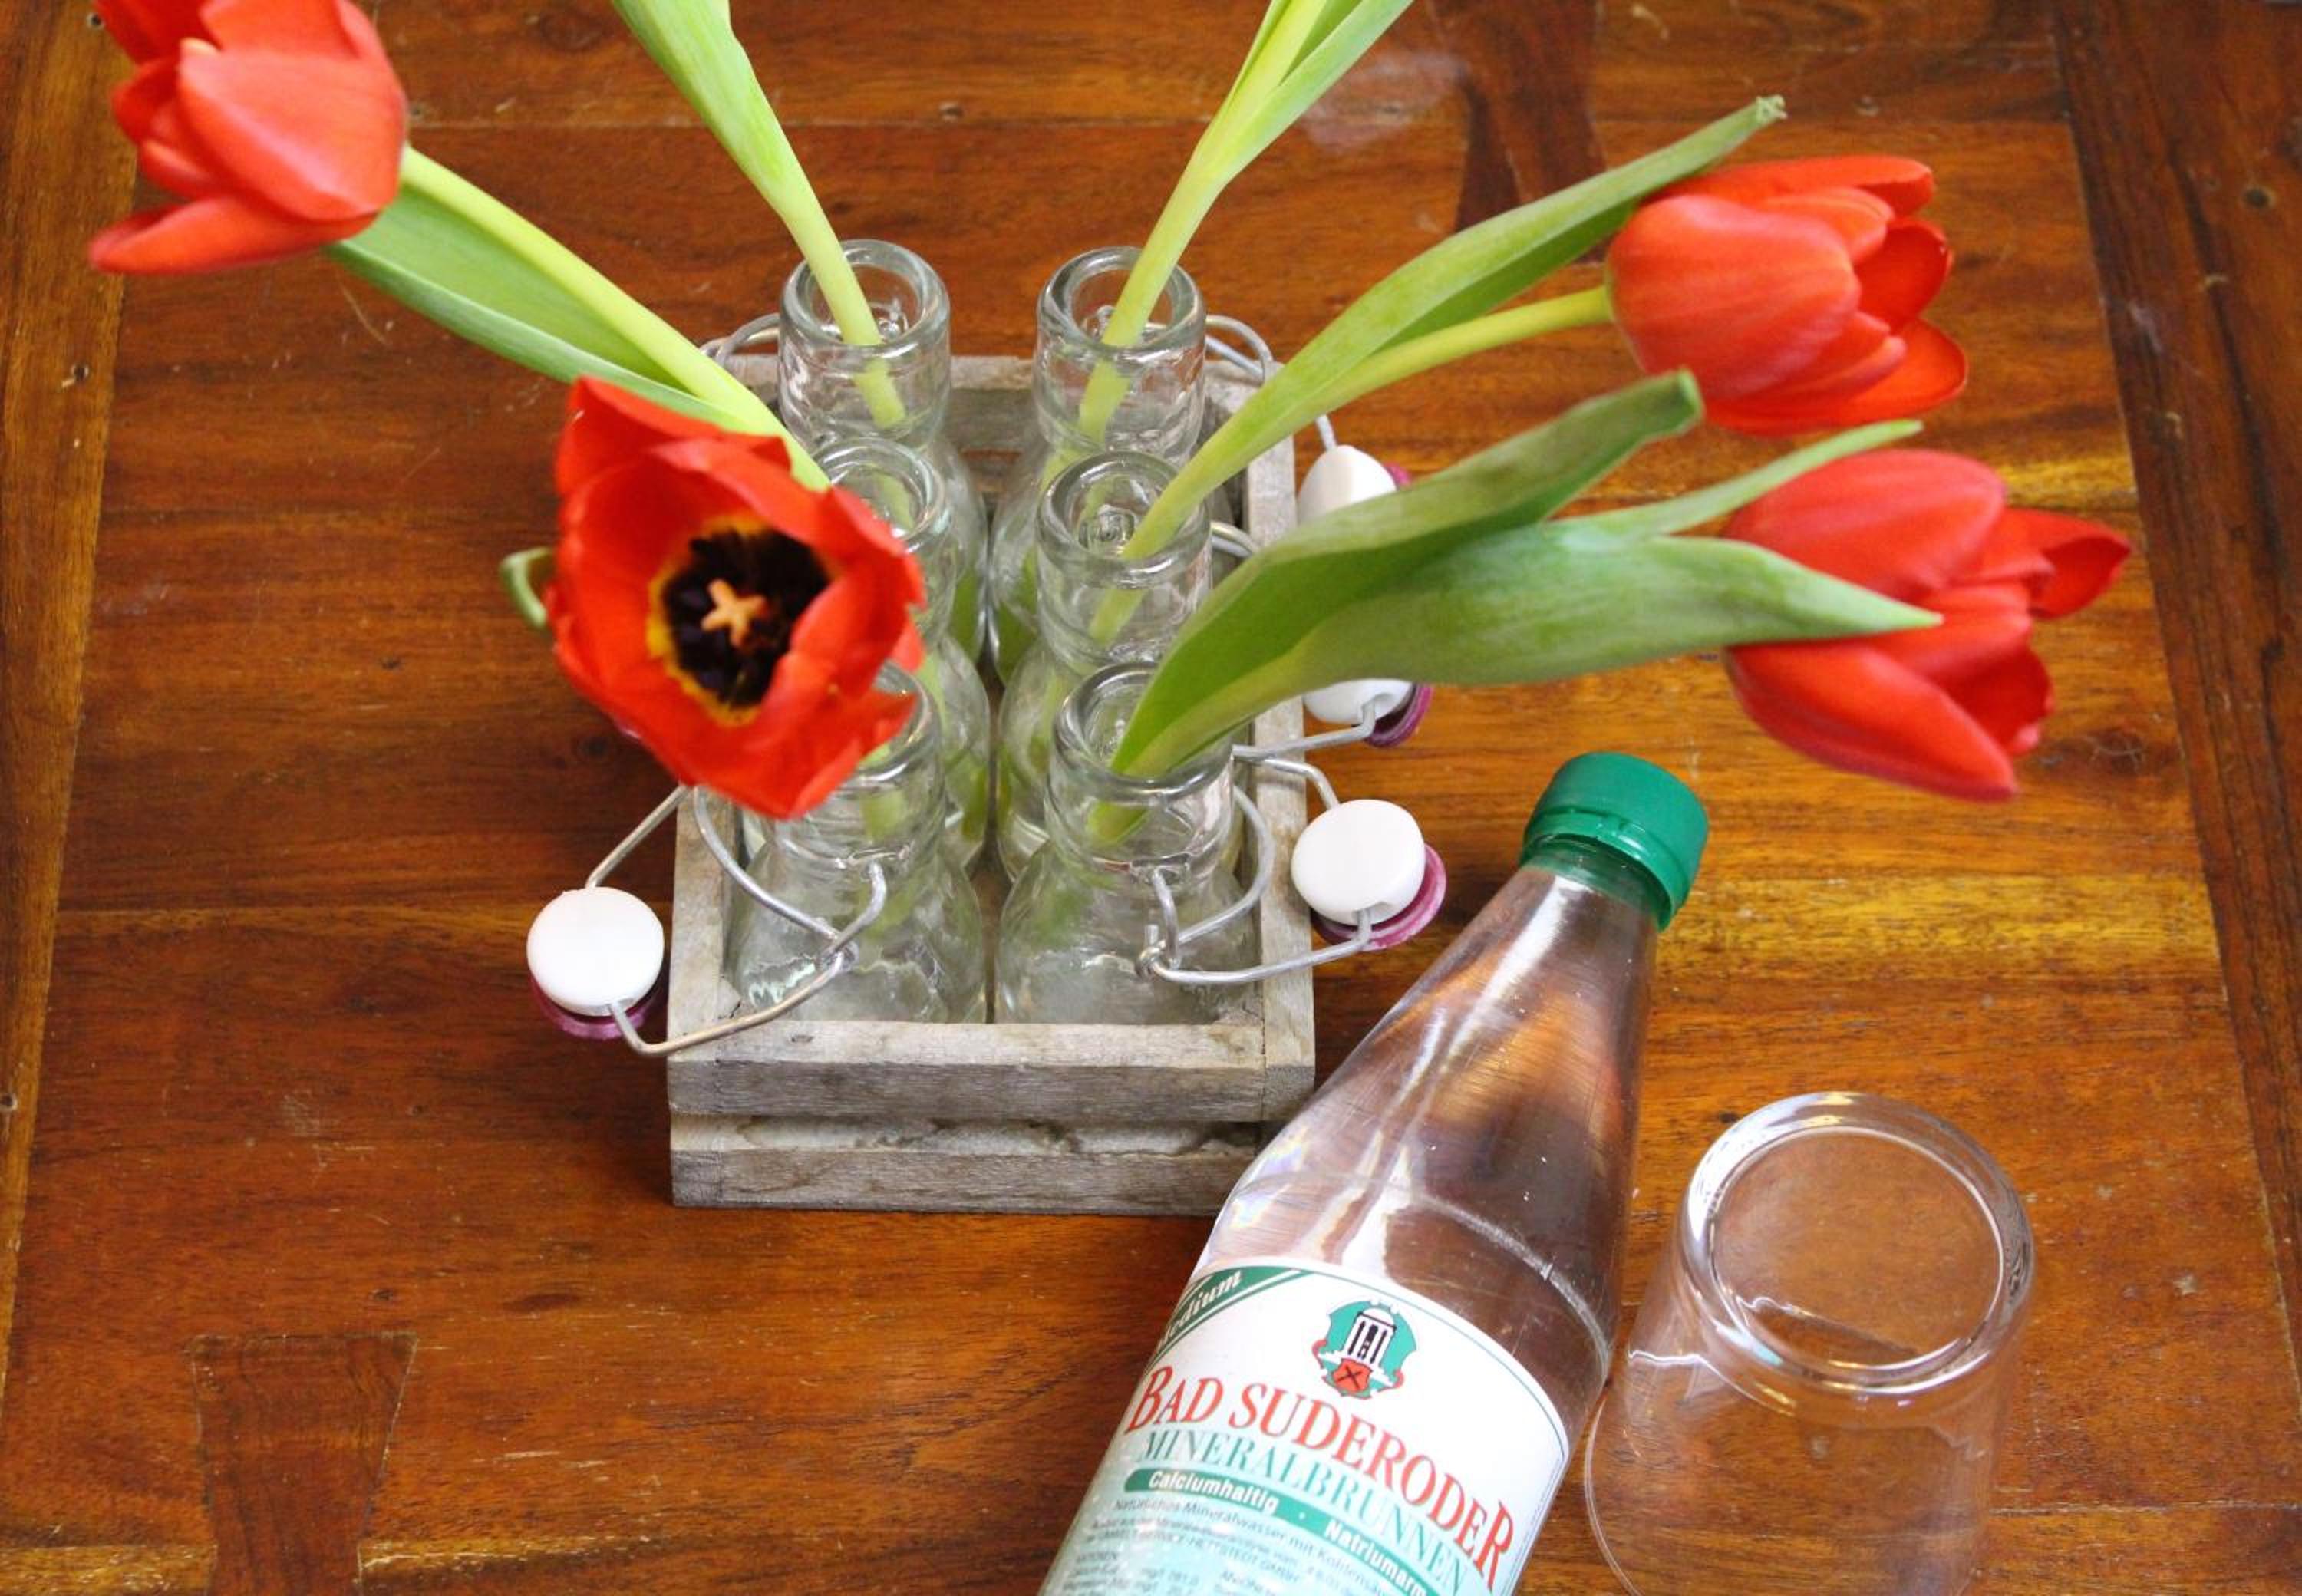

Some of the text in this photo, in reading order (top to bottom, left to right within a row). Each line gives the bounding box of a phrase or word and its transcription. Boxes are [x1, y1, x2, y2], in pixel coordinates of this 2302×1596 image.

[1124, 1365, 1514, 1593] BAD SUDERODER
[1139, 1429, 1468, 1596] MINERALBRUNNEN
[1149, 1469, 1280, 1516] Calciumhaltig
